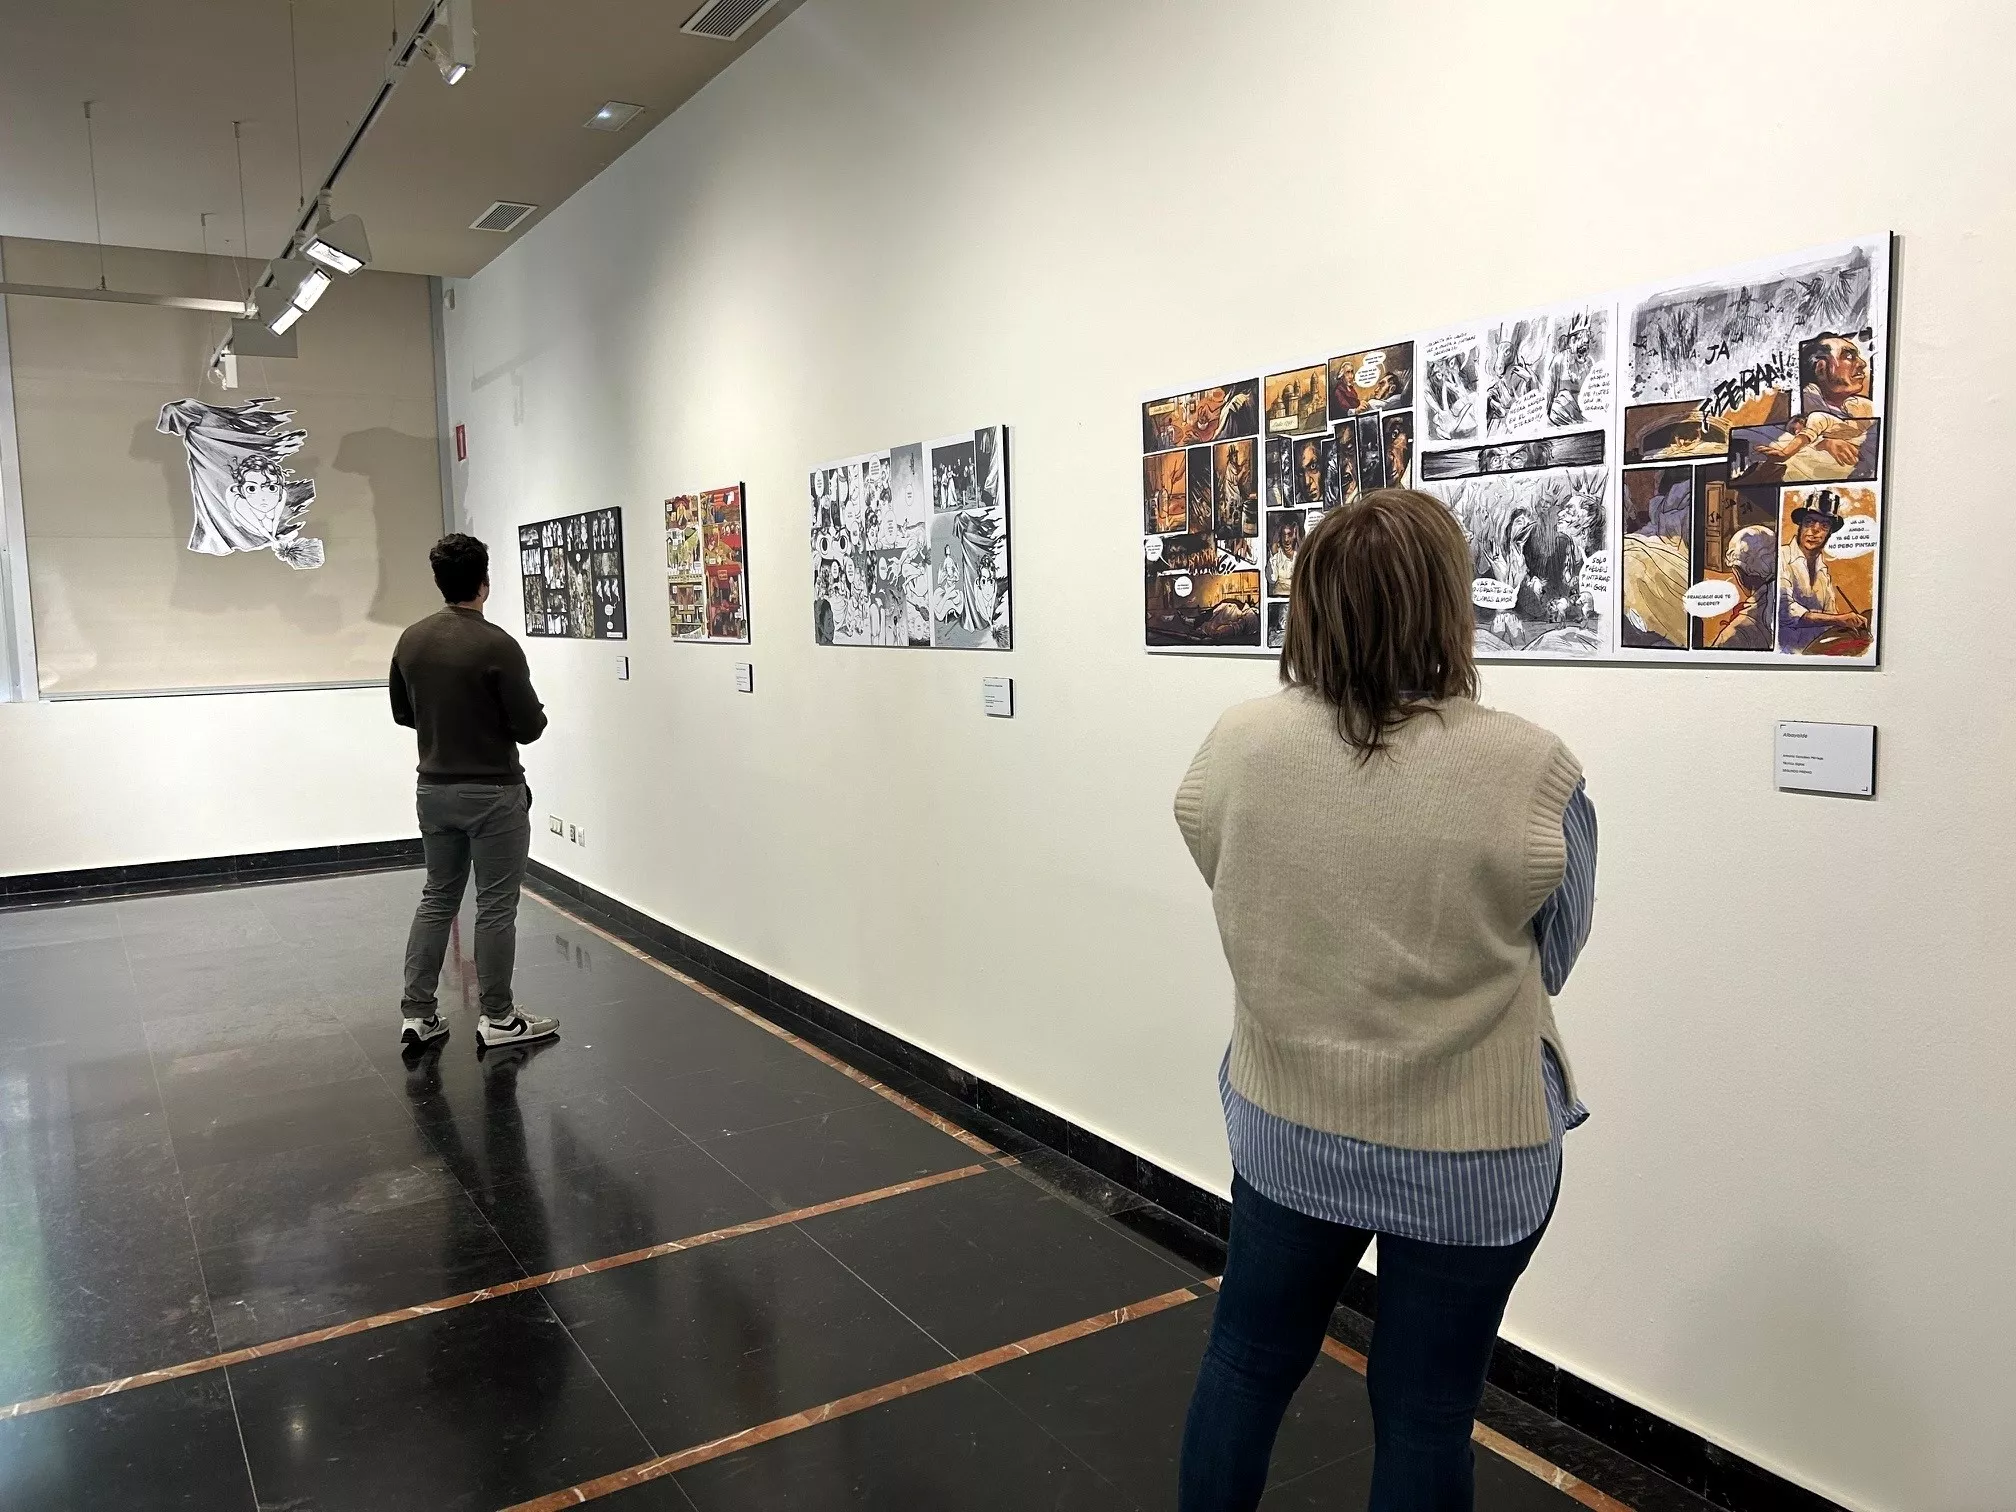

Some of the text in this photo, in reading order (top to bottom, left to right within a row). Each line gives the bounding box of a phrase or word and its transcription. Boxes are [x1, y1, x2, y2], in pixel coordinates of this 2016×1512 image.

[1704, 340, 1731, 365] JA
[1591, 556, 1607, 565] SOLO
[1593, 583, 1607, 592] GOYA
